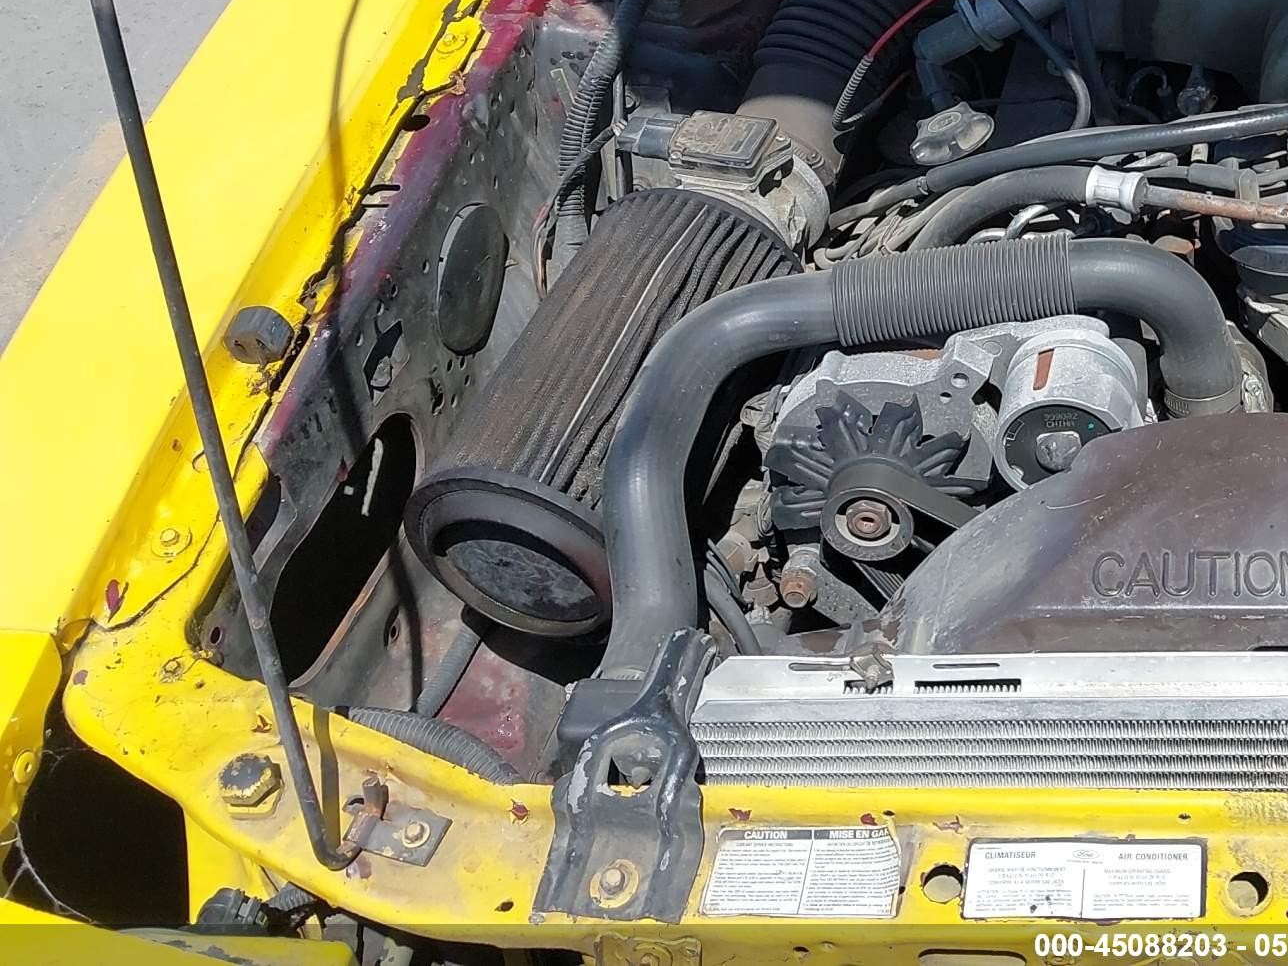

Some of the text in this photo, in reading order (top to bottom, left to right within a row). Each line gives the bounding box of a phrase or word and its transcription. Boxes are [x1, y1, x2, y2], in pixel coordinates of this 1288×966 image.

[744, 830, 788, 840] CAUTION
[829, 830, 855, 839] MISE
[855, 830, 870, 838] EN
[984, 851, 1036, 860] CLIMATISEUR
[1118, 852, 1132, 860] AIR
